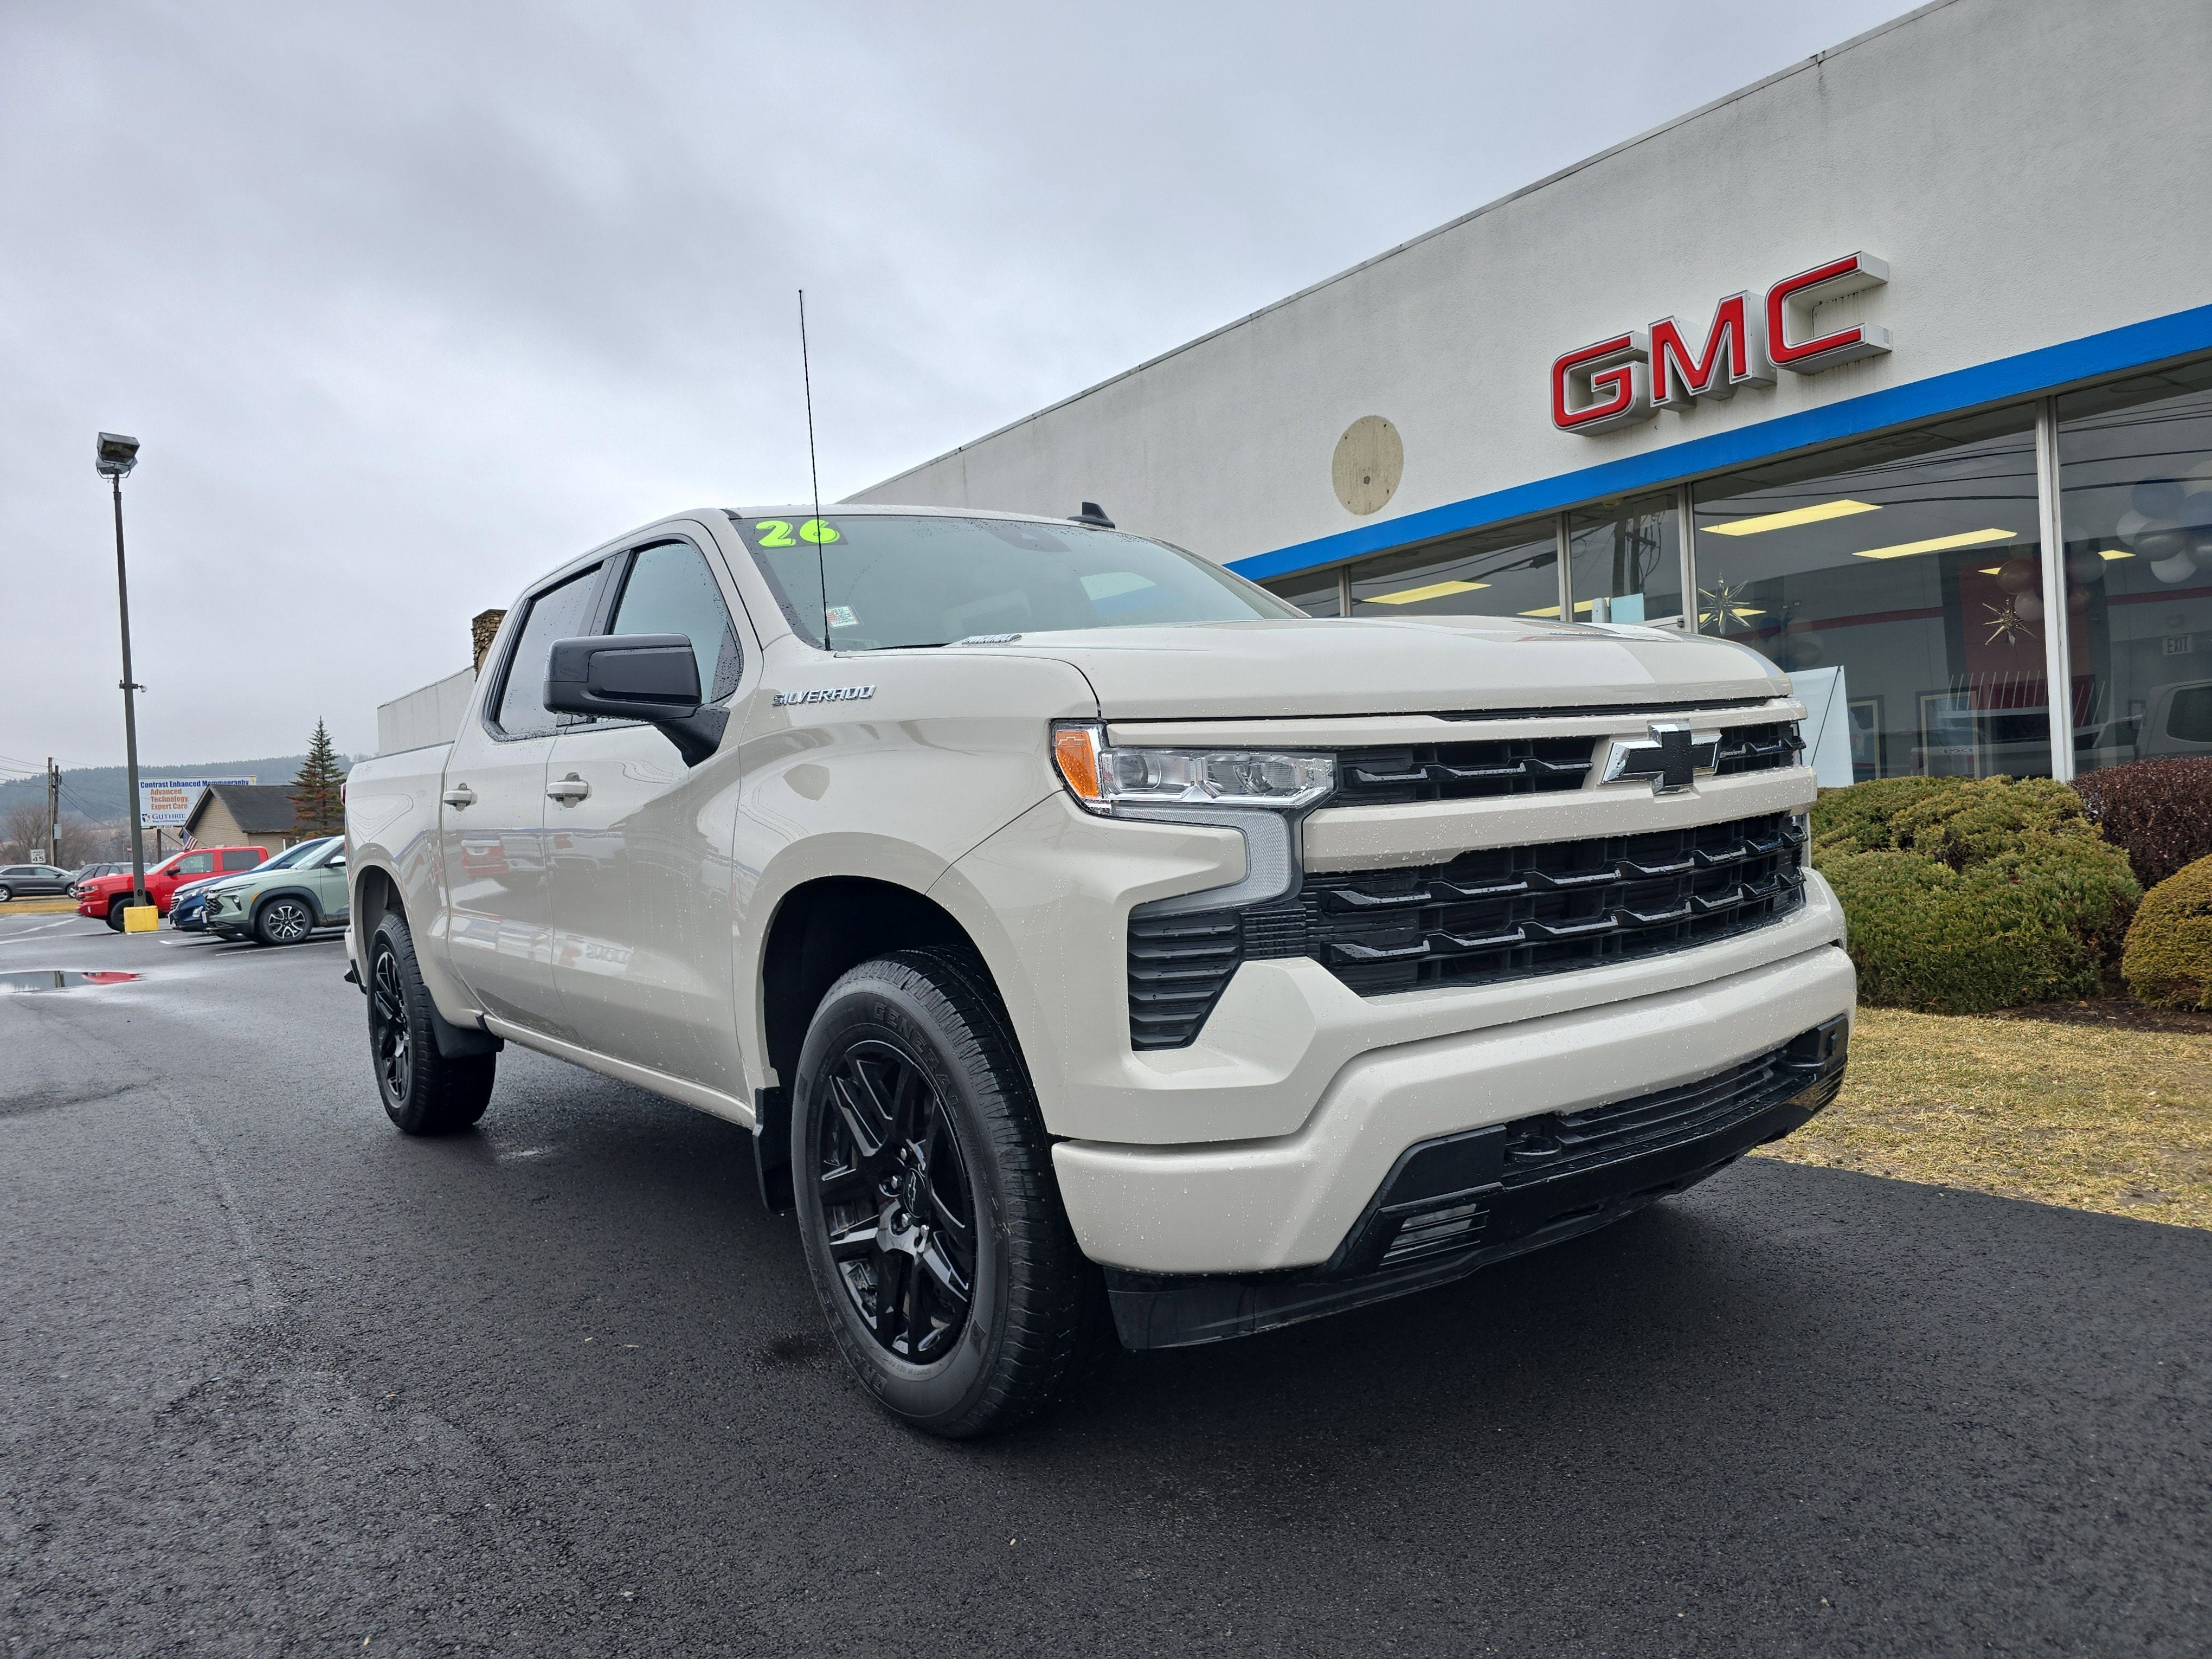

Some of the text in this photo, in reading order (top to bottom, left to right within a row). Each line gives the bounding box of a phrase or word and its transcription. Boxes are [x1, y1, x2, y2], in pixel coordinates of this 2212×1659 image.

[1551, 251, 1865, 432] GMC
[756, 519, 840, 548] 26
[2167, 635, 2188, 654] EXIT
[772, 685, 876, 707] SILVERADO
[873, 1001, 960, 1120] GENERAL
